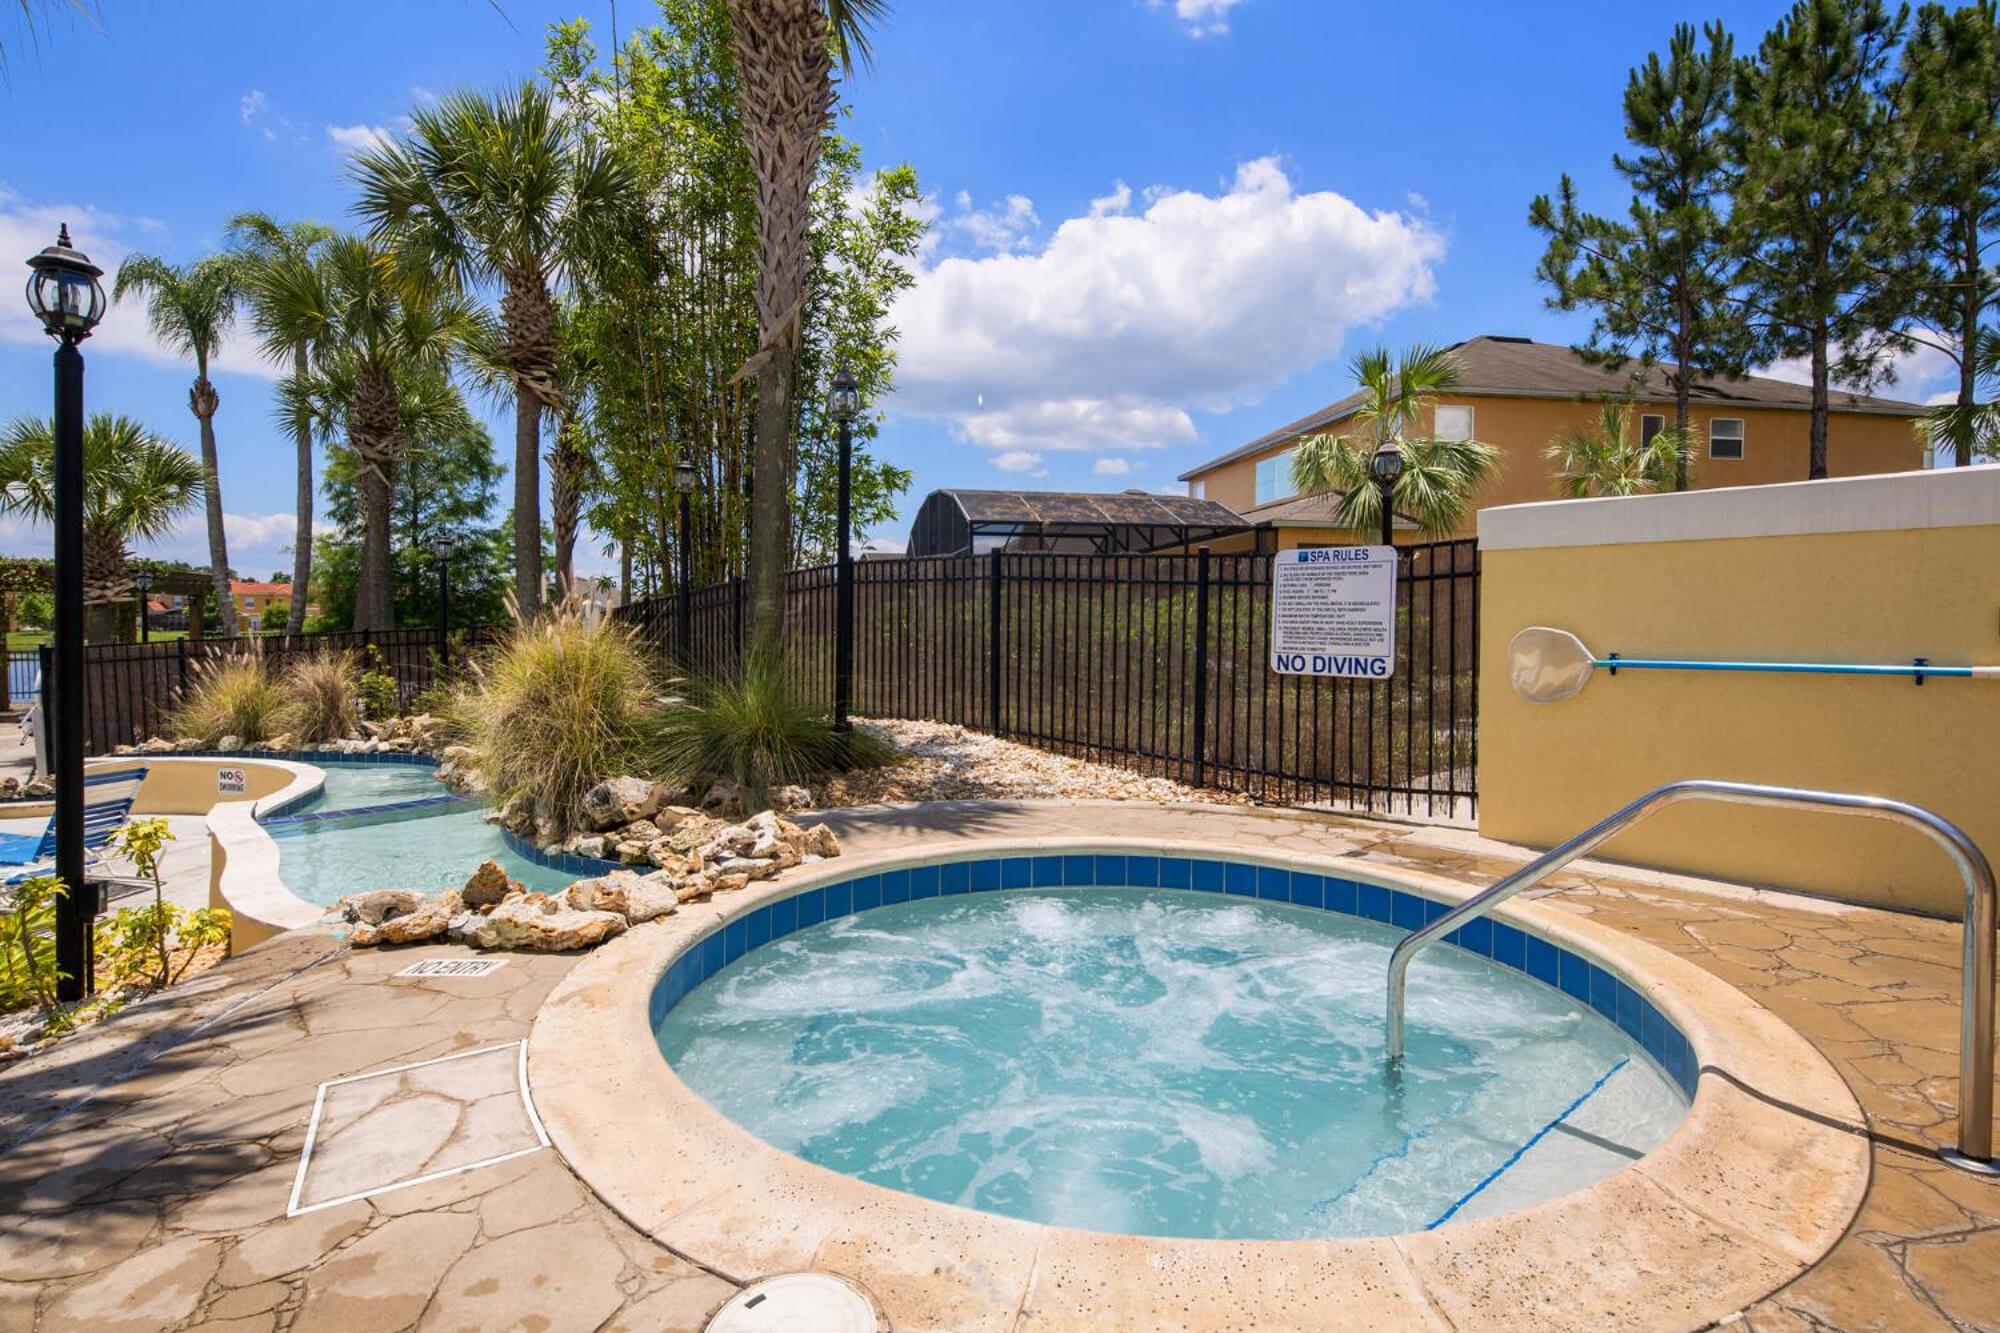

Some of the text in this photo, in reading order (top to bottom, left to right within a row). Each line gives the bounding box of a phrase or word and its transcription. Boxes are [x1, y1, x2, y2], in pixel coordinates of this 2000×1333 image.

[1310, 549, 1369, 562] SPA RULES
[1277, 654, 1386, 675] NO DIVING
[219, 771, 234, 780] NO
[405, 961, 501, 974] NO ENTRY
